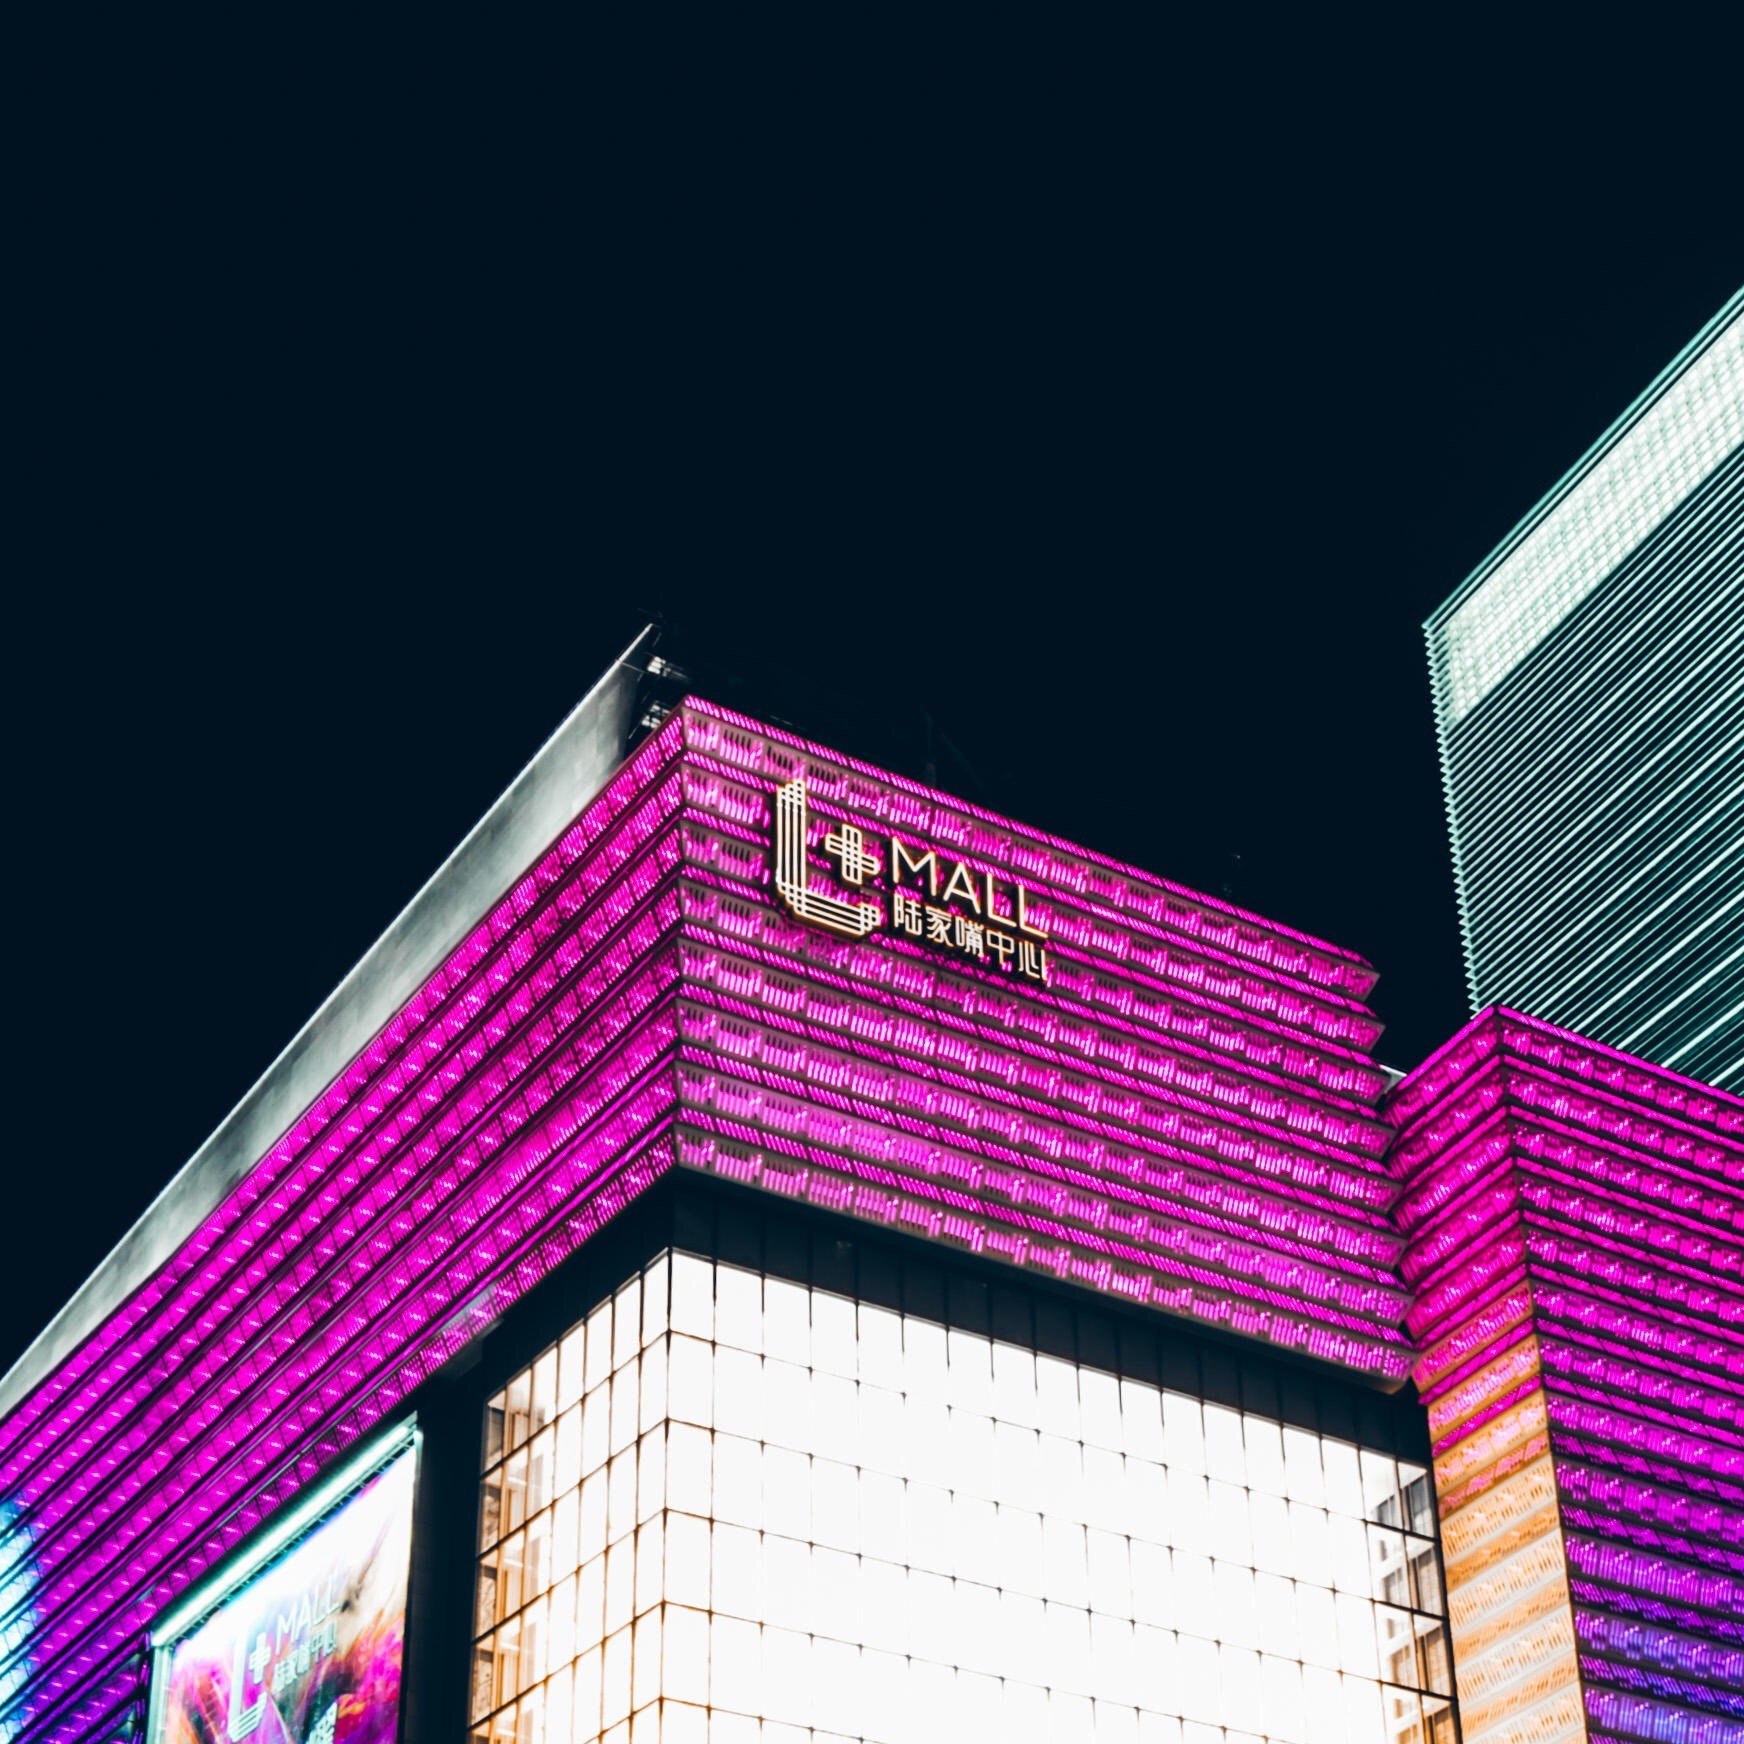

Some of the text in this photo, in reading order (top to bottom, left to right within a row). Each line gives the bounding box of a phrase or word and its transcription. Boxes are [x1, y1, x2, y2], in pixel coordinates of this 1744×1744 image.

[891, 836, 1048, 939] MALL
[893, 894, 1048, 983] 陆家嘴中心
